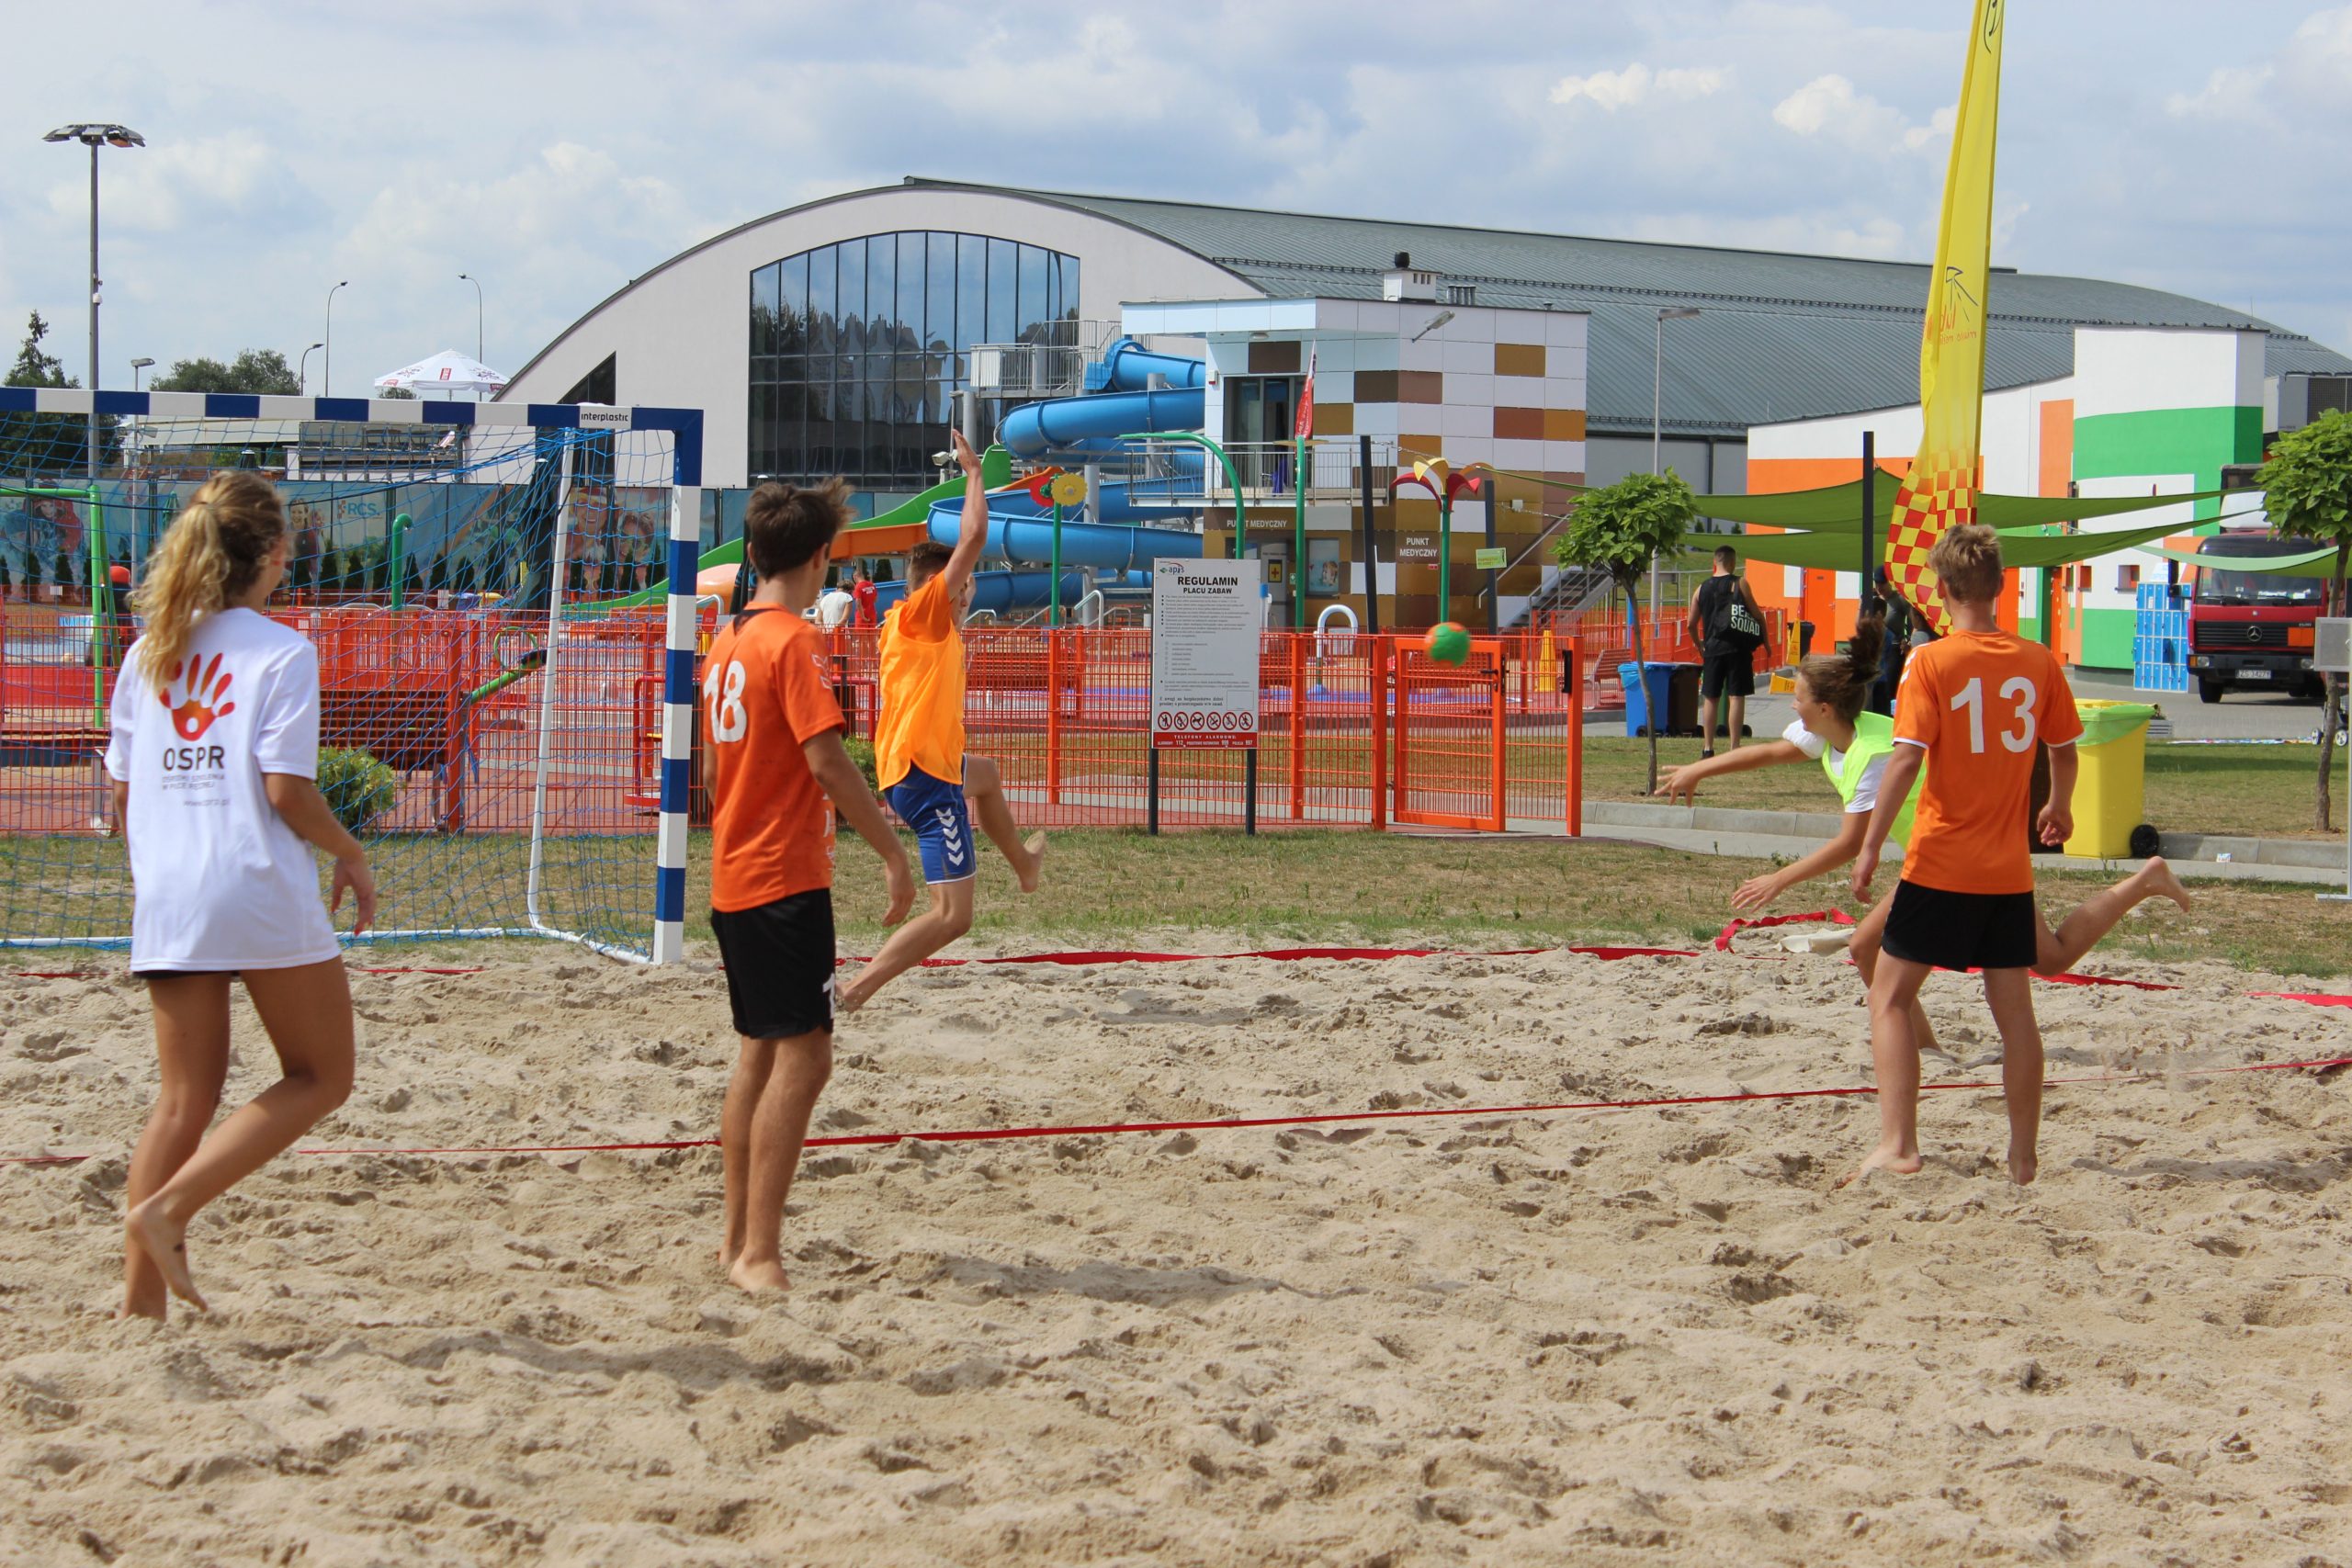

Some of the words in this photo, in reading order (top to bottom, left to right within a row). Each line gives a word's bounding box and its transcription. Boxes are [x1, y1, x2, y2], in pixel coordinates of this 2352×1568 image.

[581, 412, 628, 422] interplastic
[1399, 548, 1438, 557] MEDYCZNY
[1177, 576, 1238, 586] REGULAMIN
[1730, 616, 1760, 636] SQUAD
[703, 660, 747, 744] 18
[1951, 676, 2037, 754] 13
[163, 745, 225, 771] OSPR
